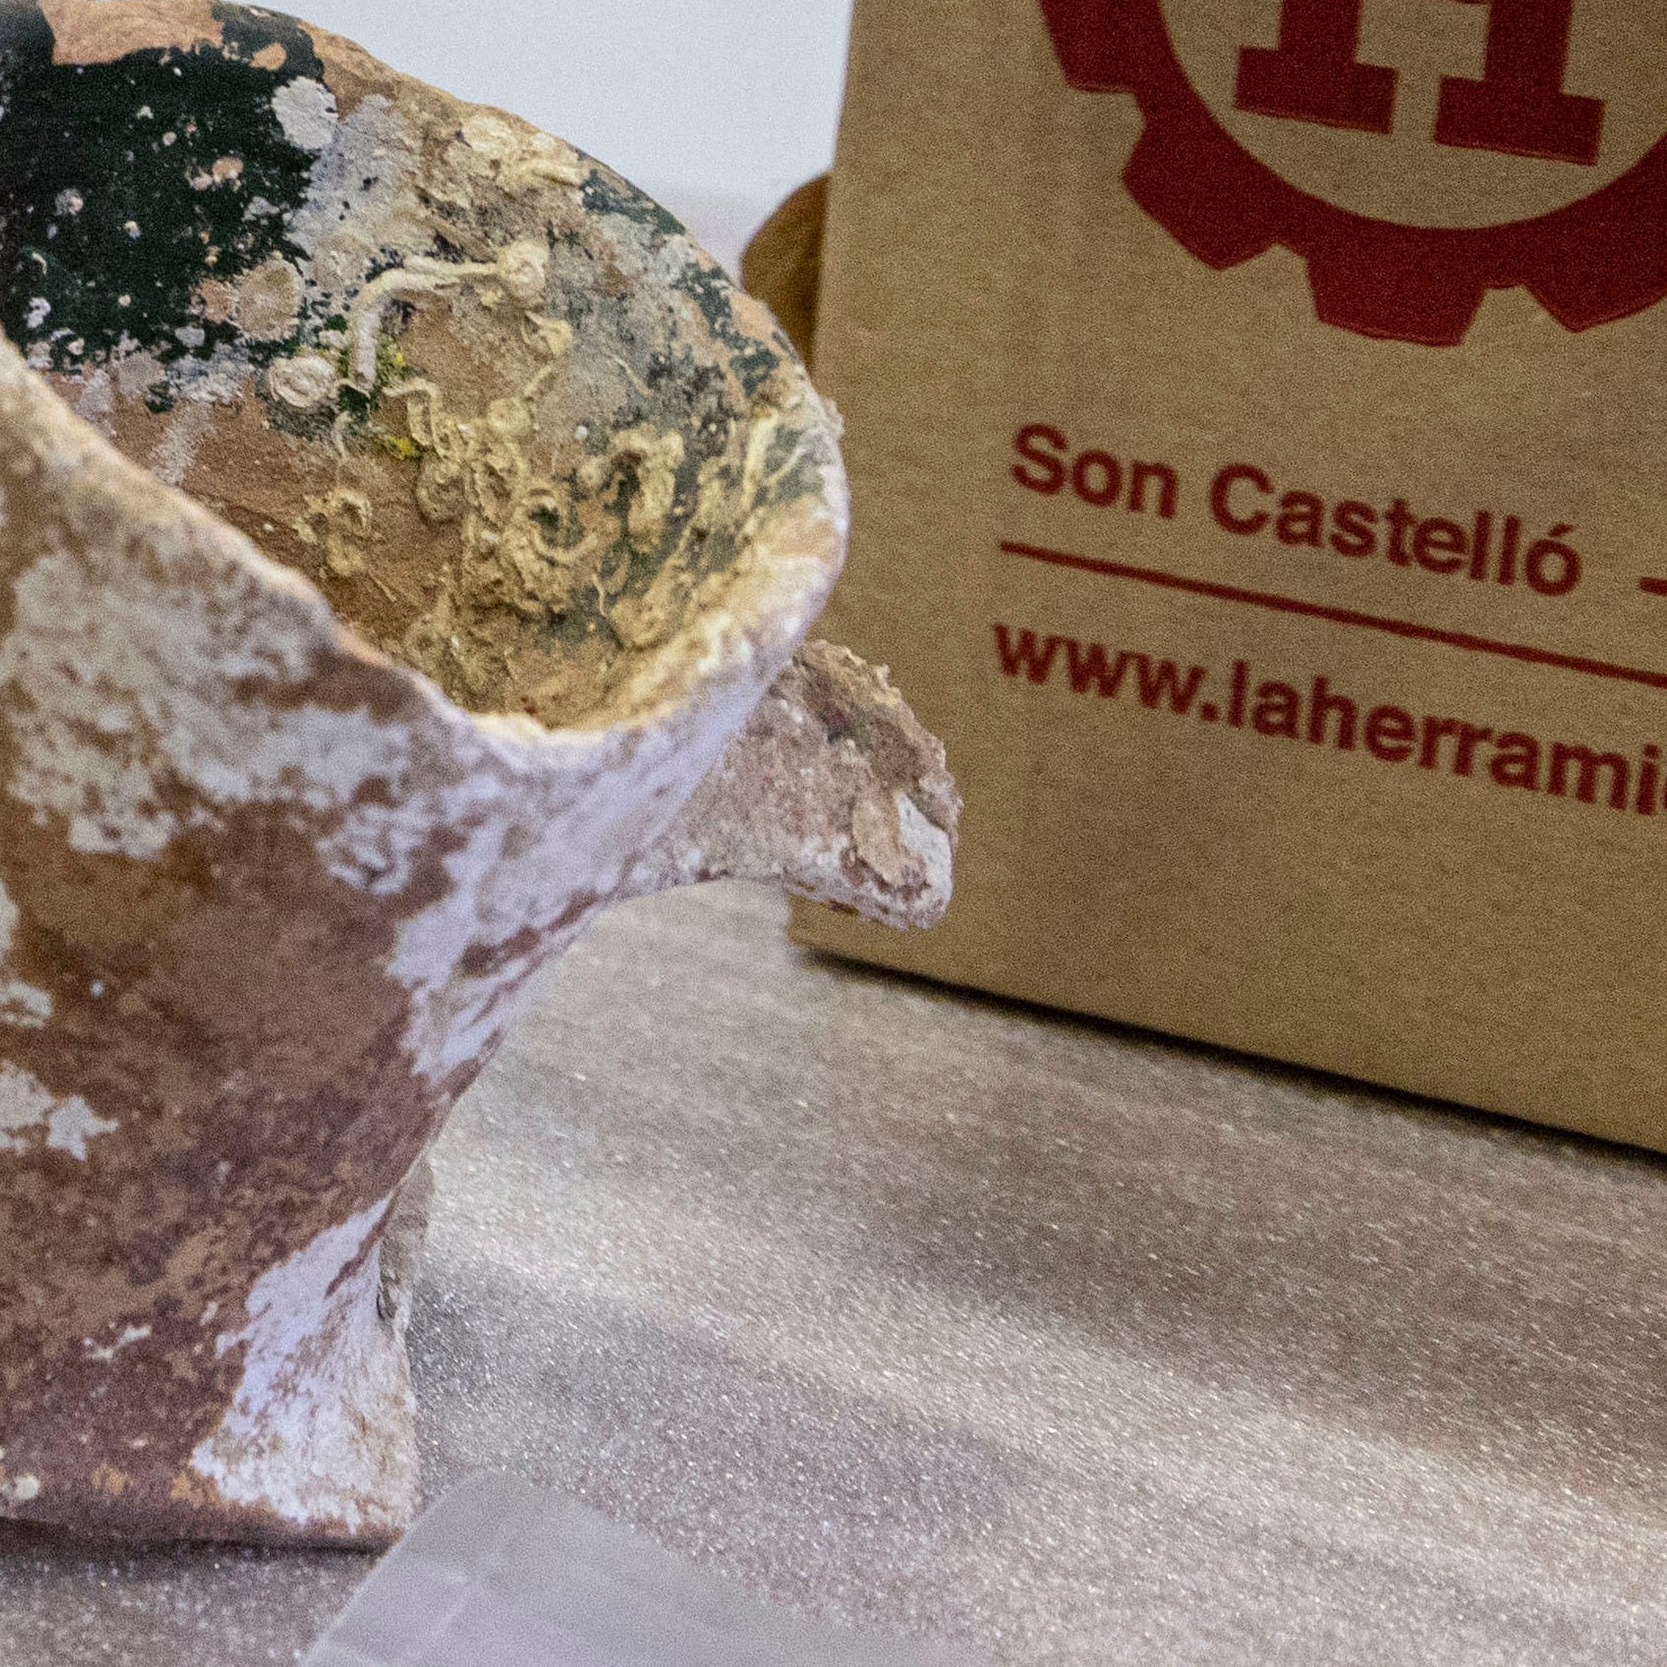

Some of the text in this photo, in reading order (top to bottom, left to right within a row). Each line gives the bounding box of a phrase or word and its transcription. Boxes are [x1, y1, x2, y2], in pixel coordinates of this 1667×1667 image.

[1009, 423, 1179, 520] Son
[1209, 462, 1582, 598] Castelló
[992, 623, 1667, 816] www.laherrami
